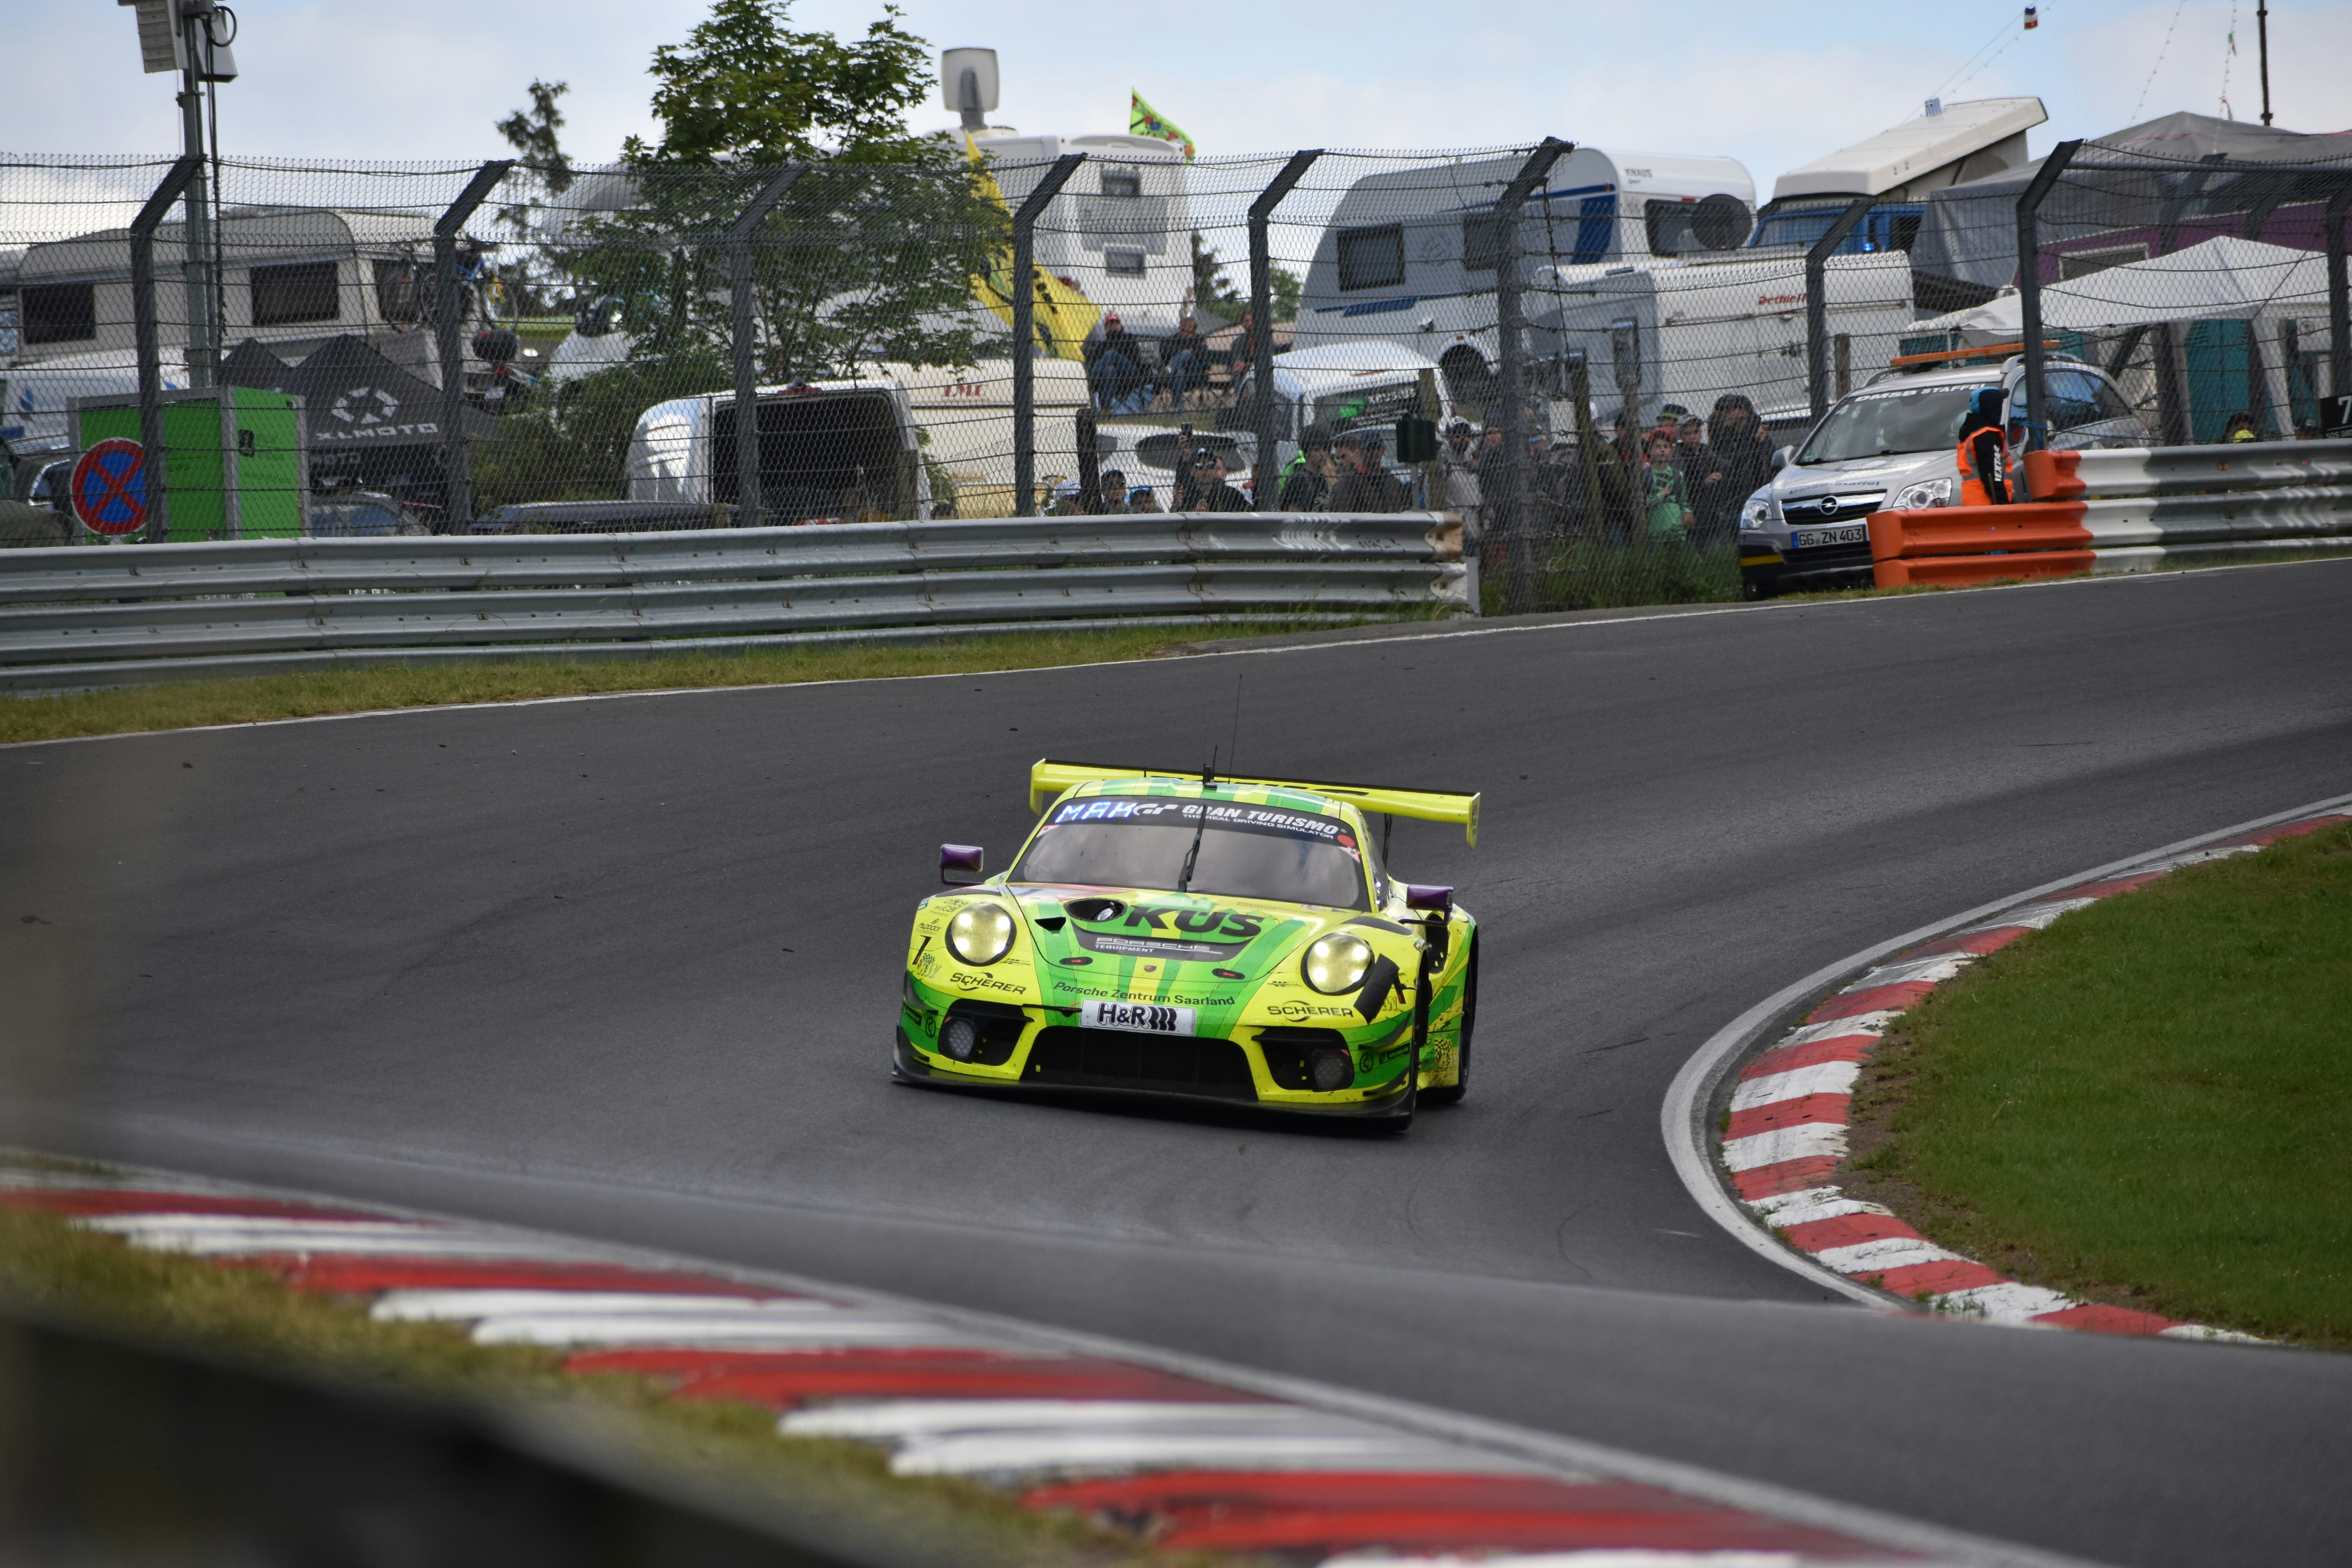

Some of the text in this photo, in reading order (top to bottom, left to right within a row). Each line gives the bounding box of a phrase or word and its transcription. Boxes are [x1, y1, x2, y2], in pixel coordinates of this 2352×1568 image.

[1758, 293, 1807, 306] Dethleff
[315, 423, 439, 440] XLMOTO
[1799, 529, 1862, 545] GG ZN 403
[1182, 804, 1339, 834] GRAN TURISMO
[1238, 818, 1274, 827] DRIVING
[1276, 824, 1334, 839] SIMULATOR
[1096, 937, 1210, 950] PORSCHE
[1096, 944, 1154, 953] TEQUIPMENT
[950, 973, 1027, 995] SCHERER
[1054, 982, 1236, 1005] Porsche Zentrum Saarland
[1098, 1002, 1149, 1029] H&R
[1267, 1005, 1354, 1018] SCHERER
